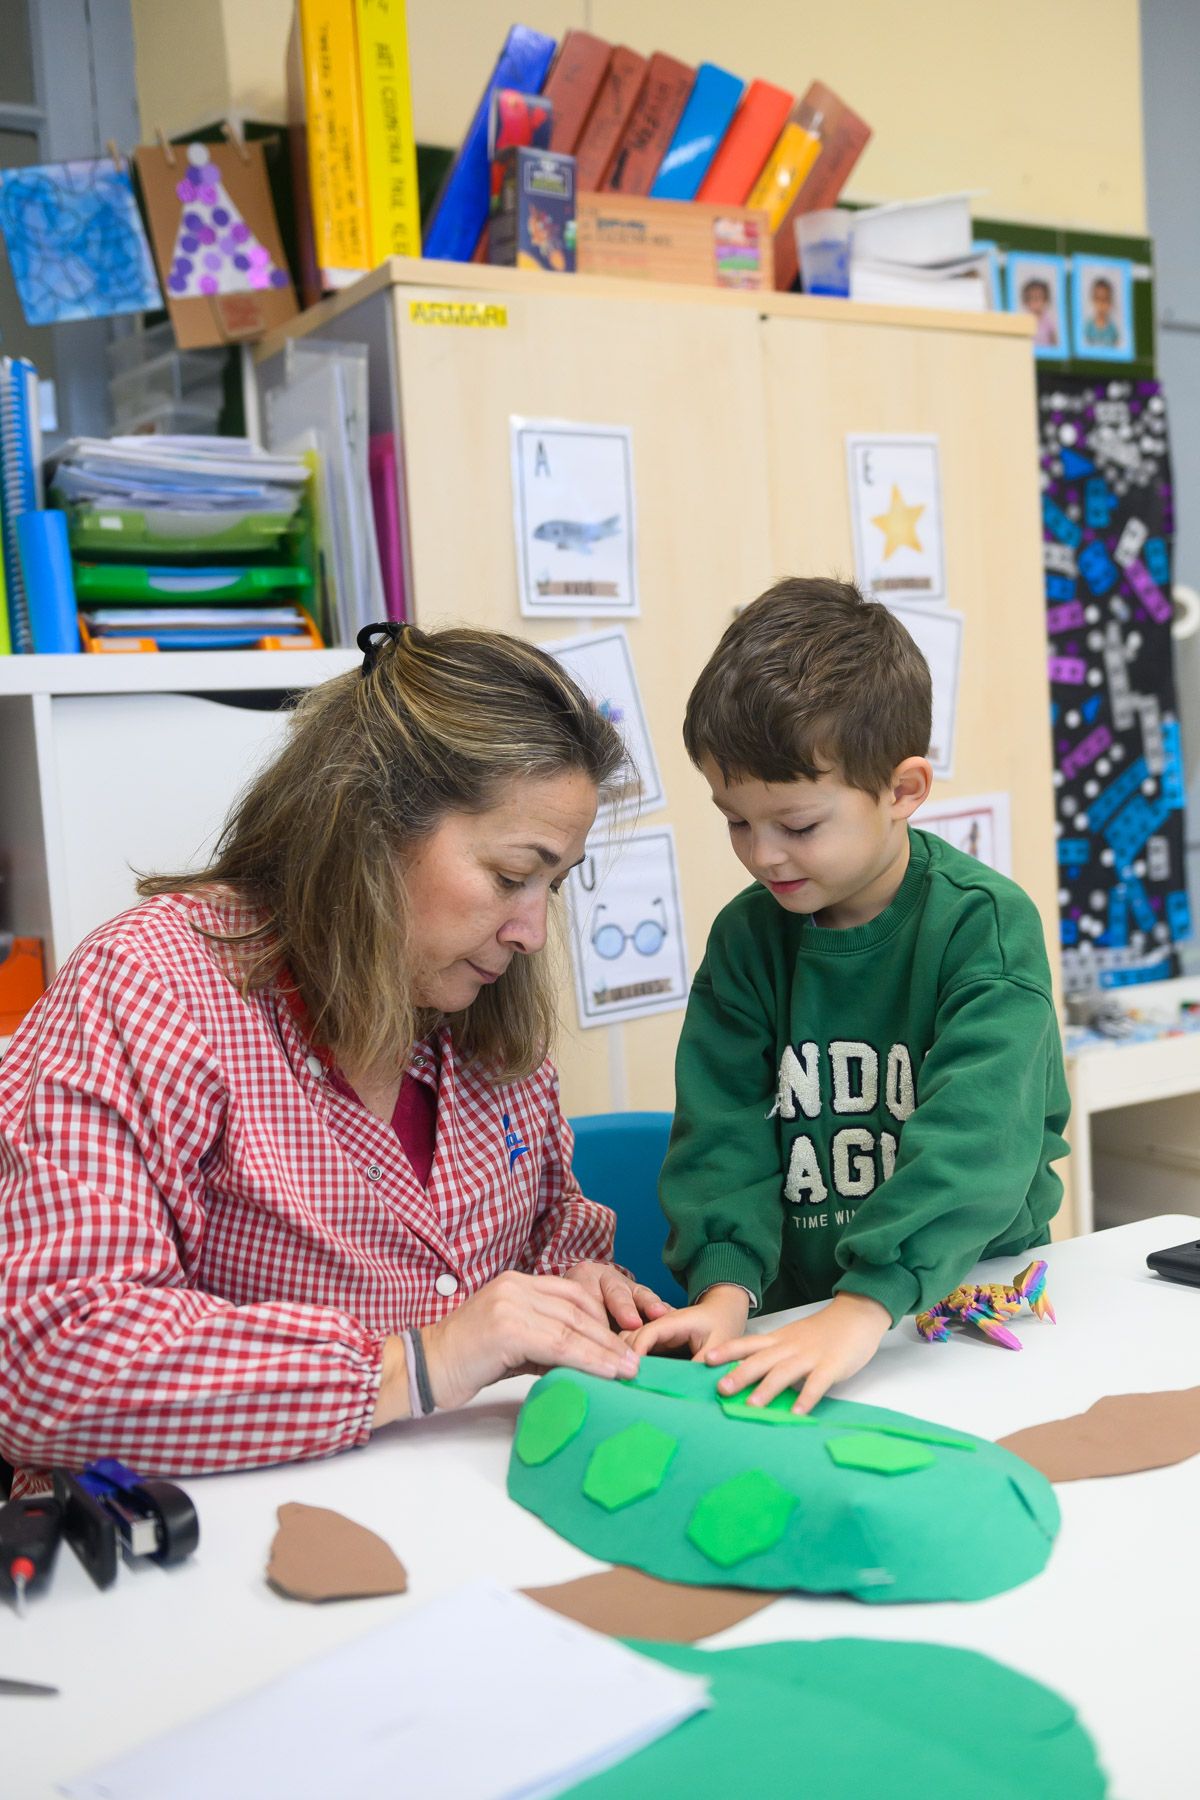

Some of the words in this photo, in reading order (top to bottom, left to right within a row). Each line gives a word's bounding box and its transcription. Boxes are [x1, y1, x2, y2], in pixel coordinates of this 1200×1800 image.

[534, 439, 551, 477] A
[578, 855, 596, 891] U
[778, 1041, 930, 1122] NDO
[792, 1213, 829, 1229] TIME
